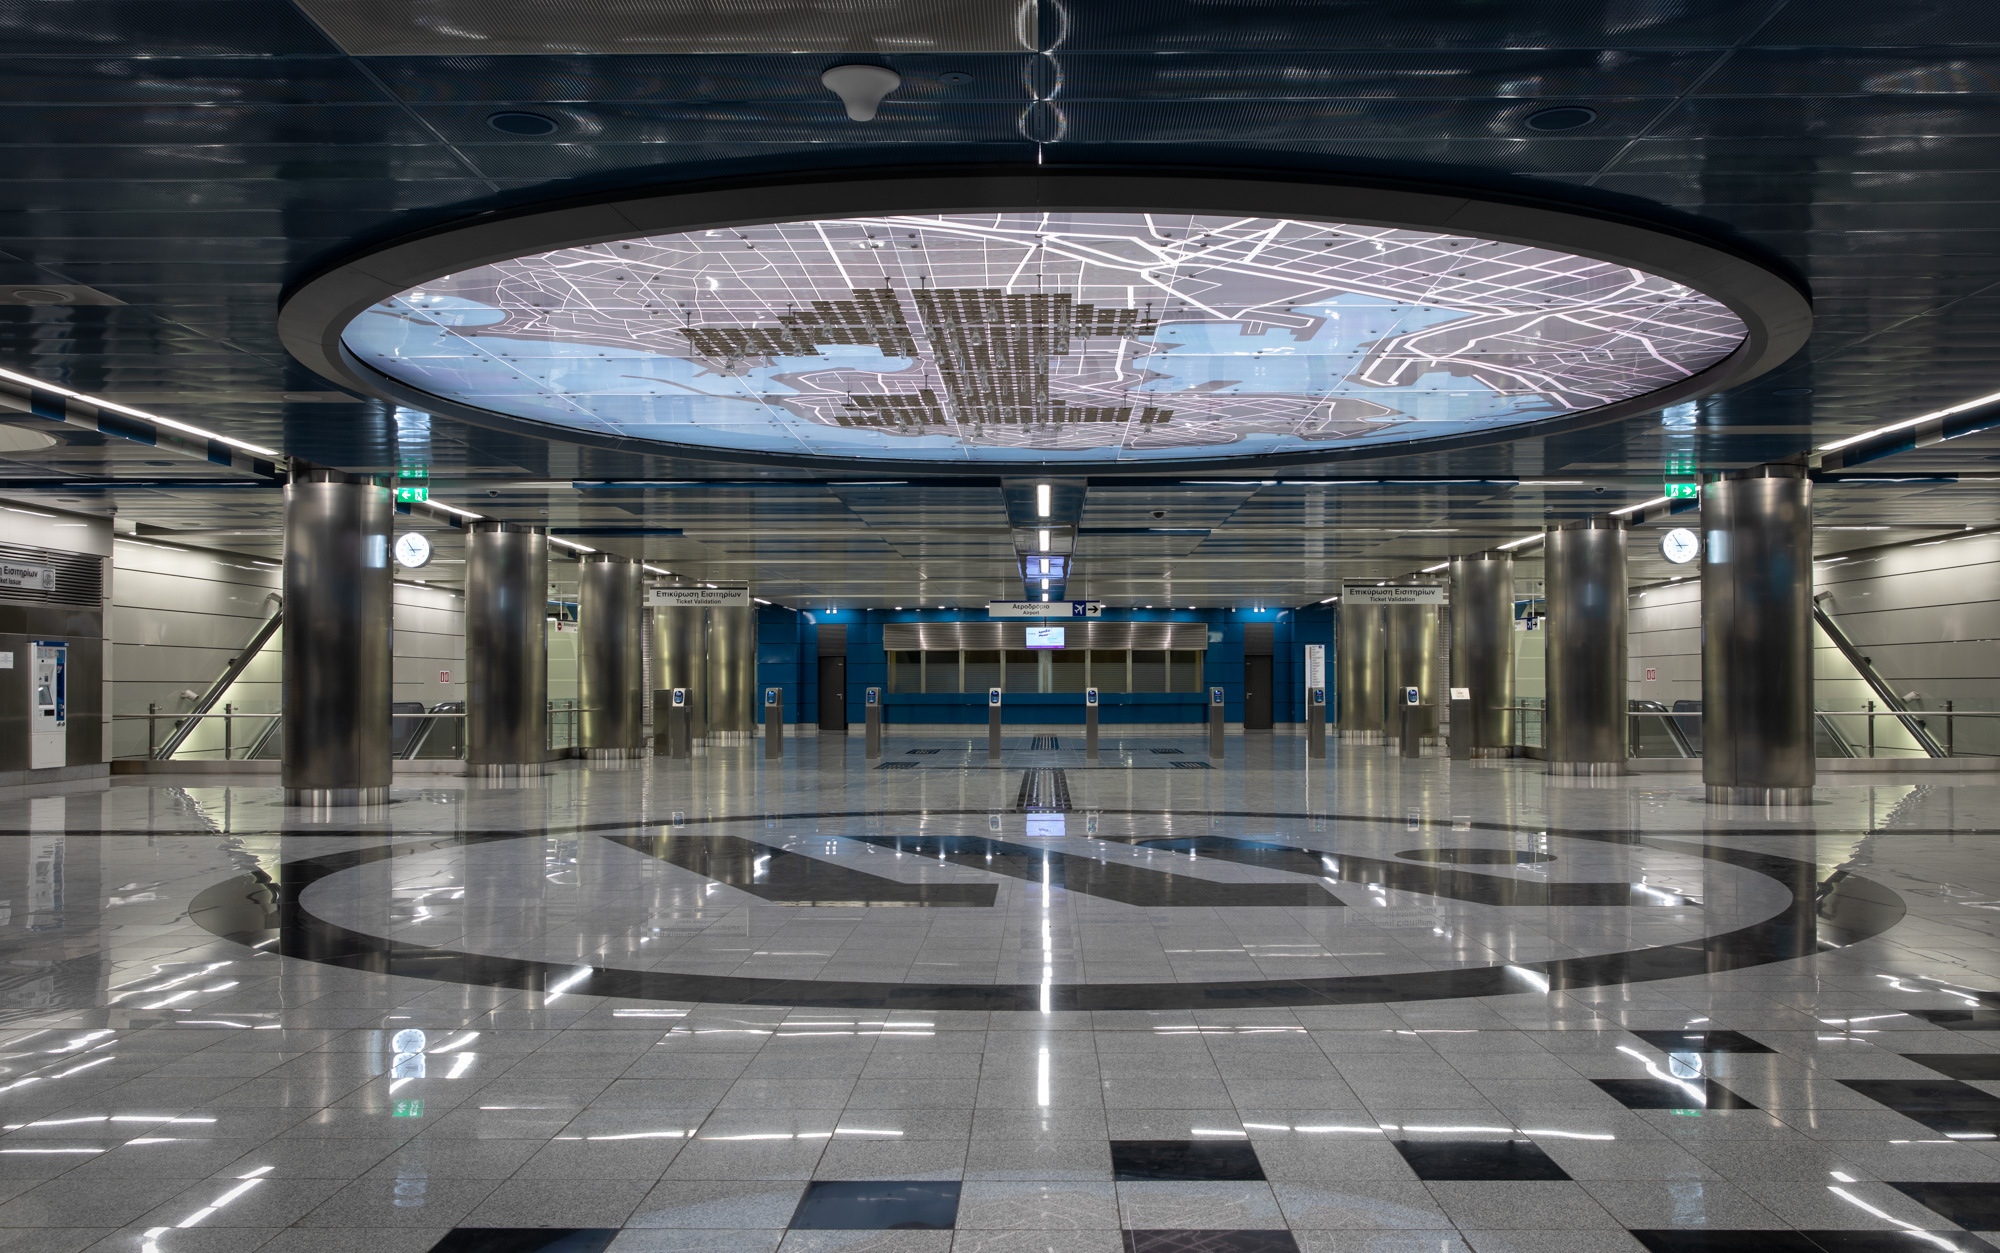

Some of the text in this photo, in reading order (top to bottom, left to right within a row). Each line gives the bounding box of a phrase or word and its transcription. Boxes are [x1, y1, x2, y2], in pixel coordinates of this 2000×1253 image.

[656, 590, 742, 598] Επικύρωση Εισιτηρίων
[1349, 588, 1436, 596] Επικύρωση Εισιτηρίων
